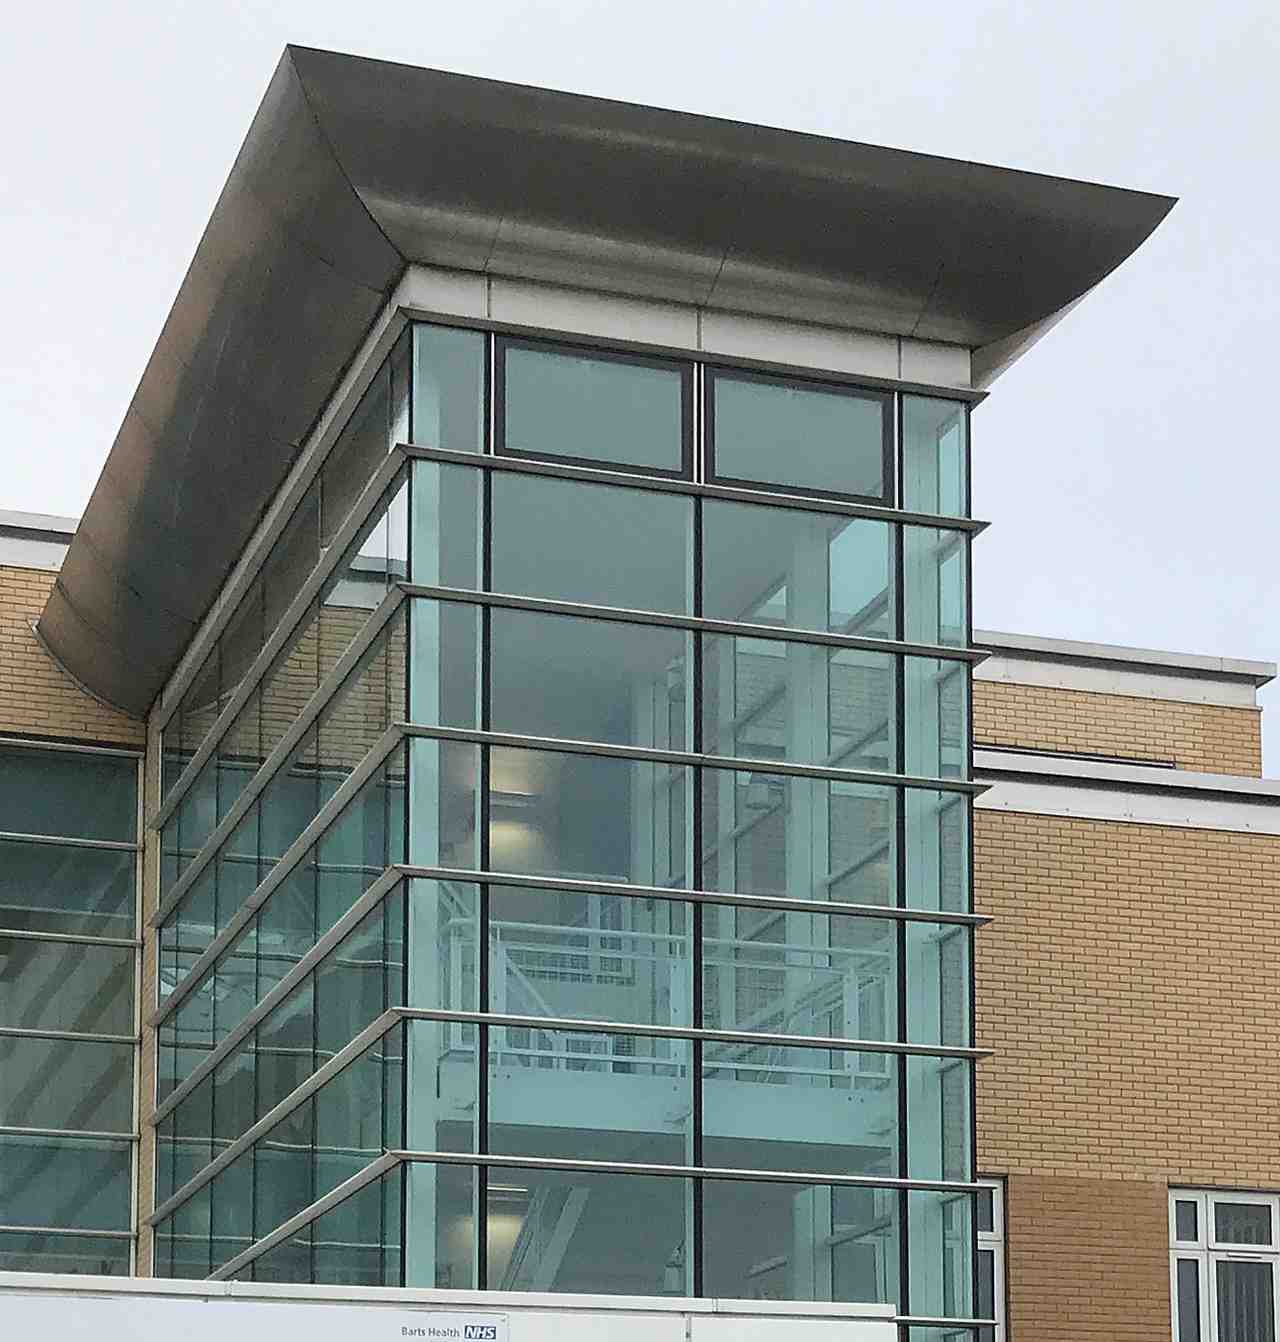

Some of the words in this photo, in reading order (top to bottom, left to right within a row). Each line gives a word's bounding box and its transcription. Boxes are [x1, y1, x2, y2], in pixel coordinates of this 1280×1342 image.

[401, 1326, 426, 1337] Barts
[428, 1327, 460, 1337] Health
[465, 1325, 496, 1339] NHS
